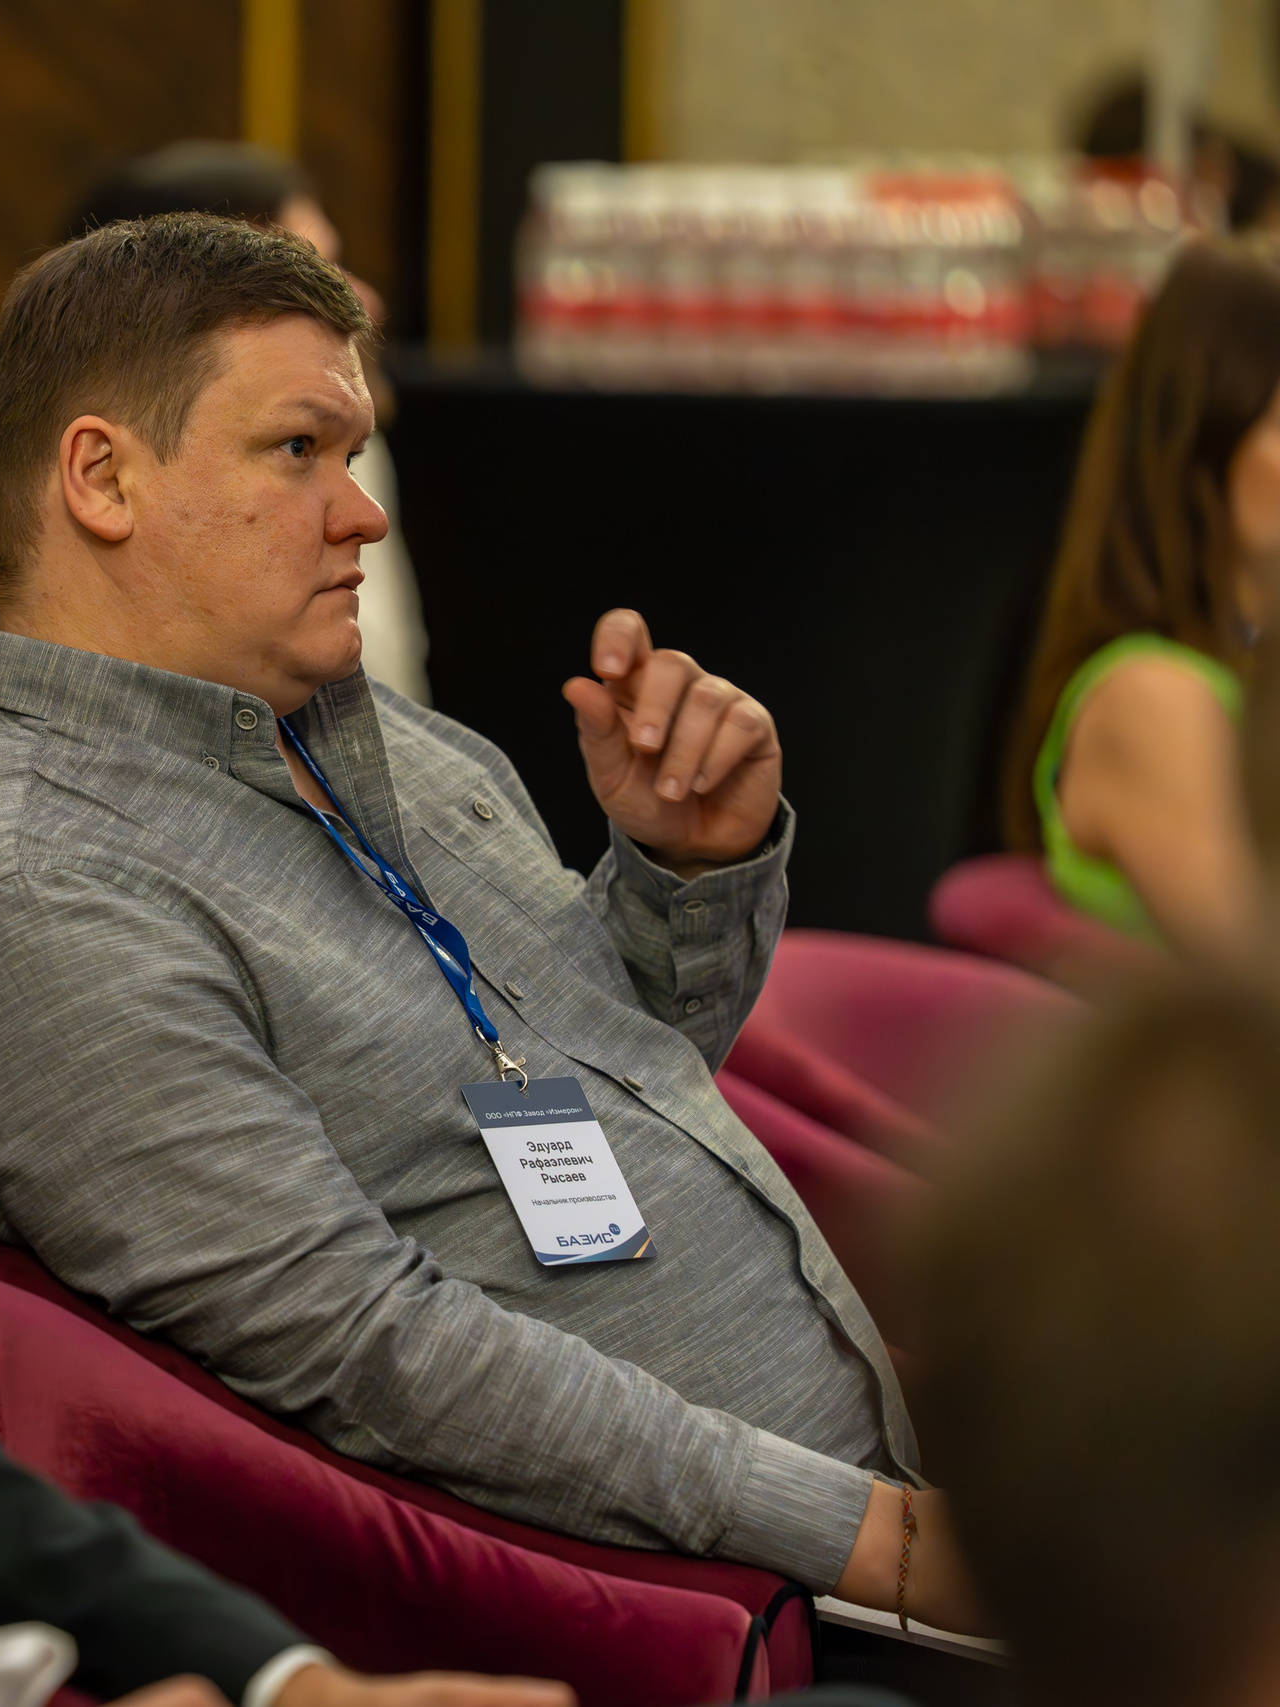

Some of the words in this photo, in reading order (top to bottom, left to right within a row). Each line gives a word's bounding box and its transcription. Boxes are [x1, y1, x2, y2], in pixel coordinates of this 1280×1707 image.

[526, 1140, 573, 1154] Эдуард
[519, 1156, 593, 1171] Рафаэлевич
[540, 1173, 586, 1184] Рысаев
[568, 1194, 617, 1204] производства
[556, 1233, 614, 1247] БАЗИС
